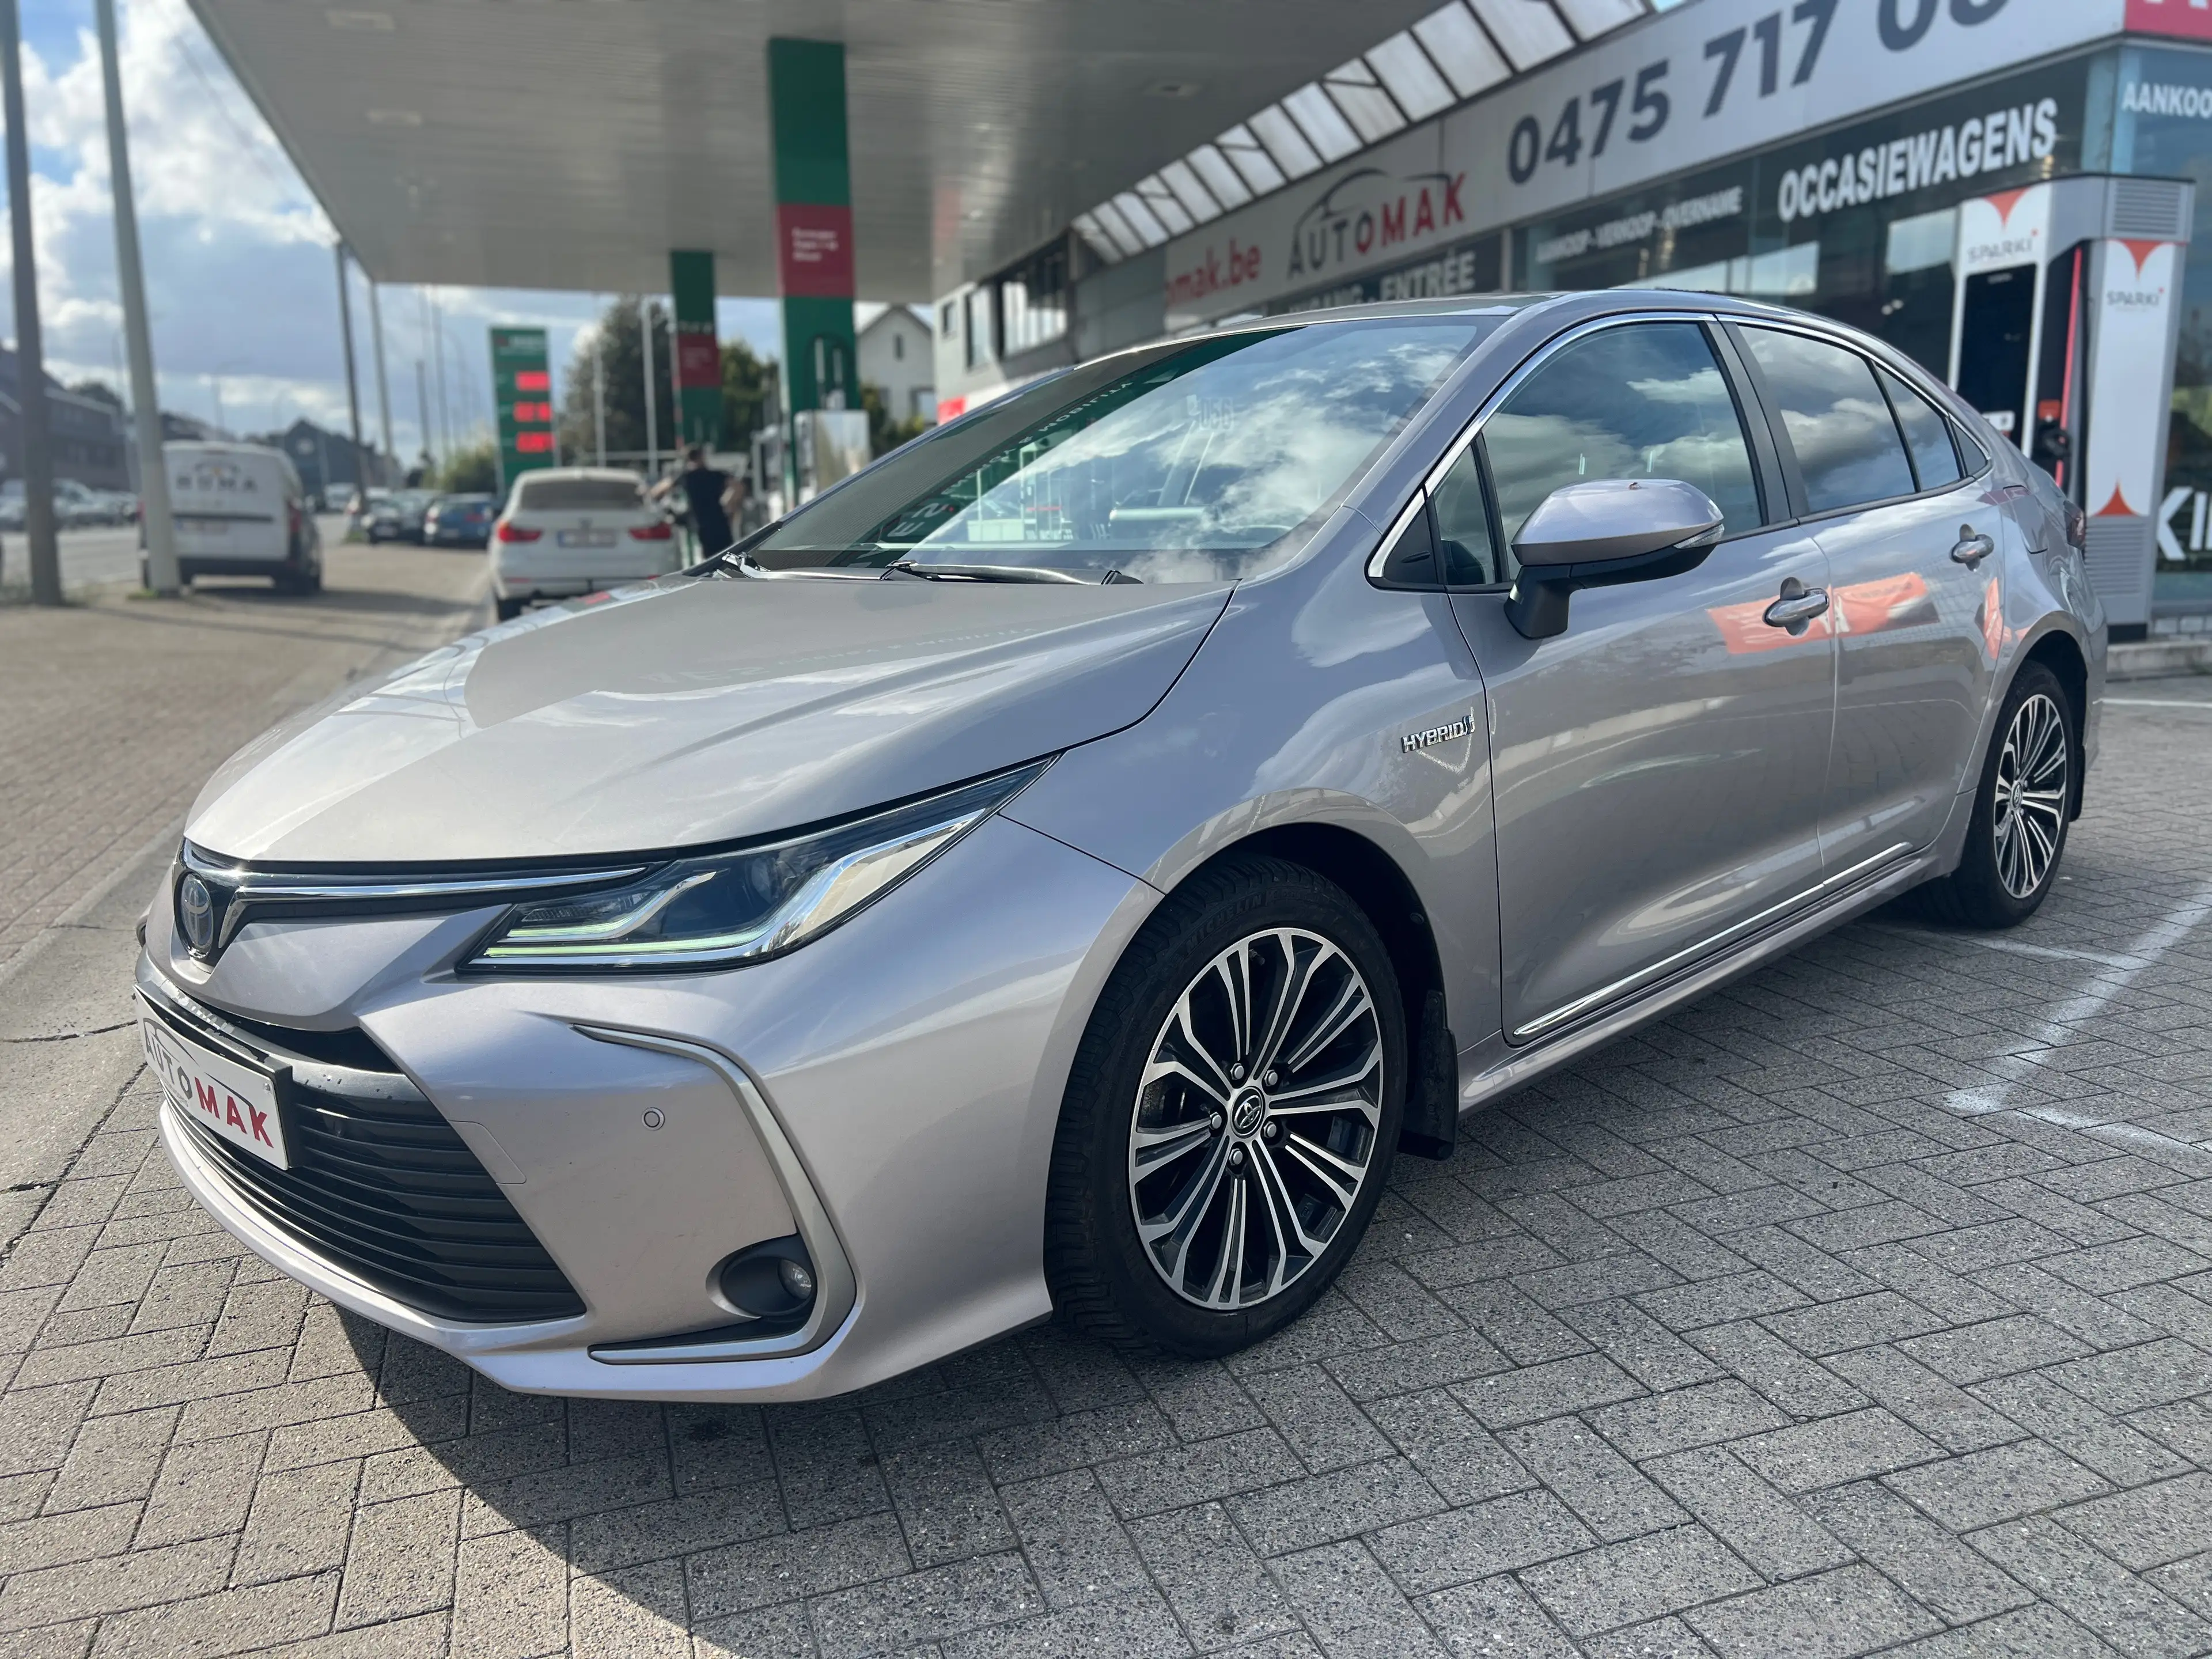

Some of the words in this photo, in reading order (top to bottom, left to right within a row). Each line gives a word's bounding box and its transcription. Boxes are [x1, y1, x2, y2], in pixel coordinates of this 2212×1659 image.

[1508, 58, 1670, 185] 0475
[1703, 0, 1841, 119] 717
[1778, 97, 2058, 222] OCCASIEWAGENS
[1287, 172, 1466, 281] AUTOMAK
[1401, 720, 1466, 753] HYBRID
[145, 1018, 275, 1149] AUTOMAK
